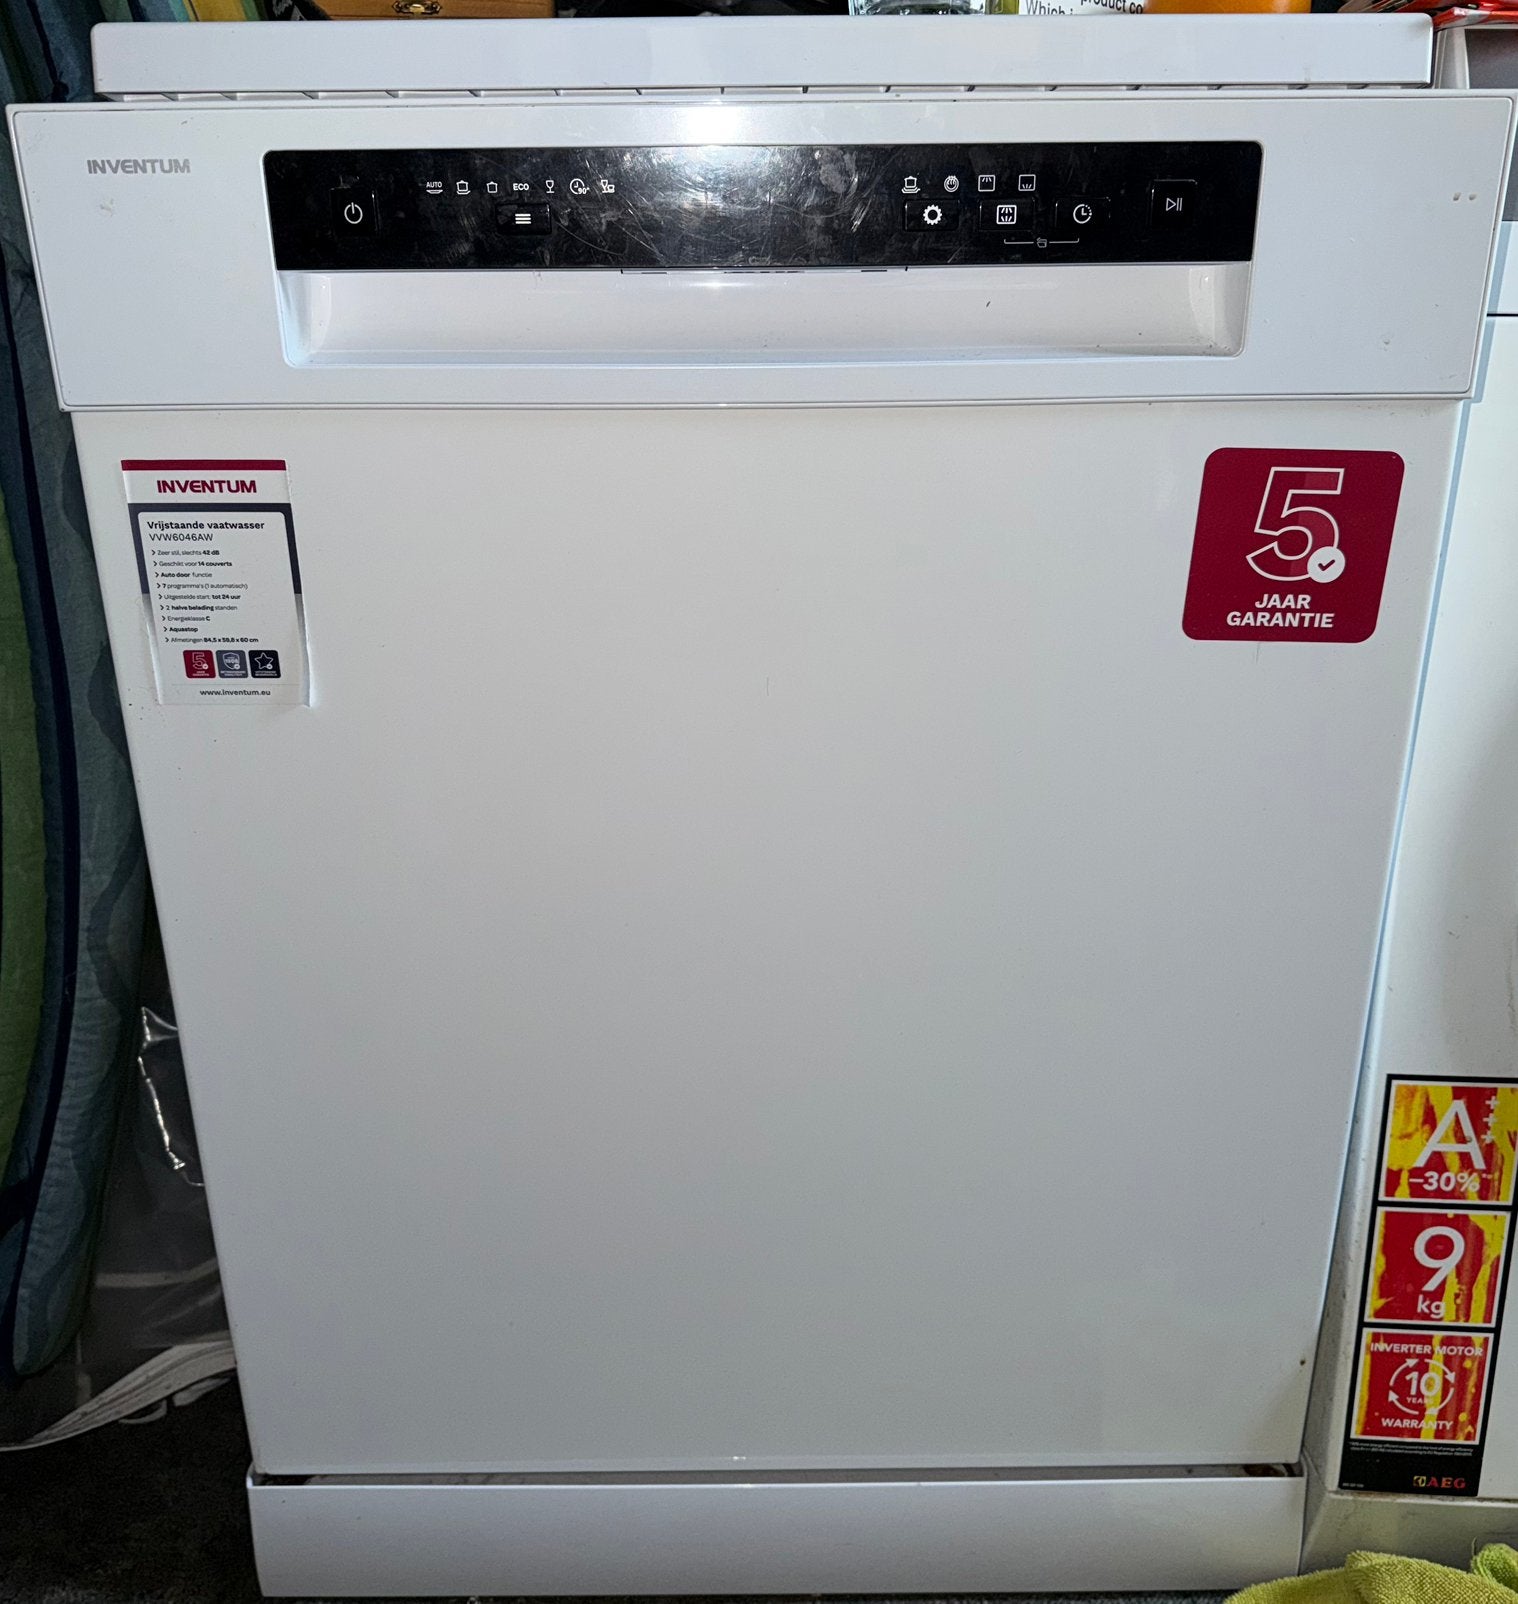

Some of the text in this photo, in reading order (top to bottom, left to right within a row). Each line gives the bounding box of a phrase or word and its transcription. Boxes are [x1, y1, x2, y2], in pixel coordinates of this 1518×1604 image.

[1080, 0, 1126, 13] oduct
[87, 158, 191, 174] INVENTUM
[426, 181, 442, 189] AUTO
[513, 183, 530, 191] ECO
[156, 479, 257, 494] INVENTUM
[147, 521, 265, 532] Vrijstaande vaatwasser
[1245, 466, 1345, 582] 5
[149, 533, 213, 542] VVW6046AW
[1255, 593, 1311, 609] JAAR
[1226, 611, 1336, 628] GARANTIE
[1413, 1225, 1466, 1292] 9
[1417, 1294, 1446, 1319] kg
[1370, 1342, 1484, 1357] INVERTER MOTOR
[1405, 1371, 1441, 1397] 10
[1381, 1417, 1454, 1431] WARRANTY
[1427, 1476, 1466, 1489] AEG
